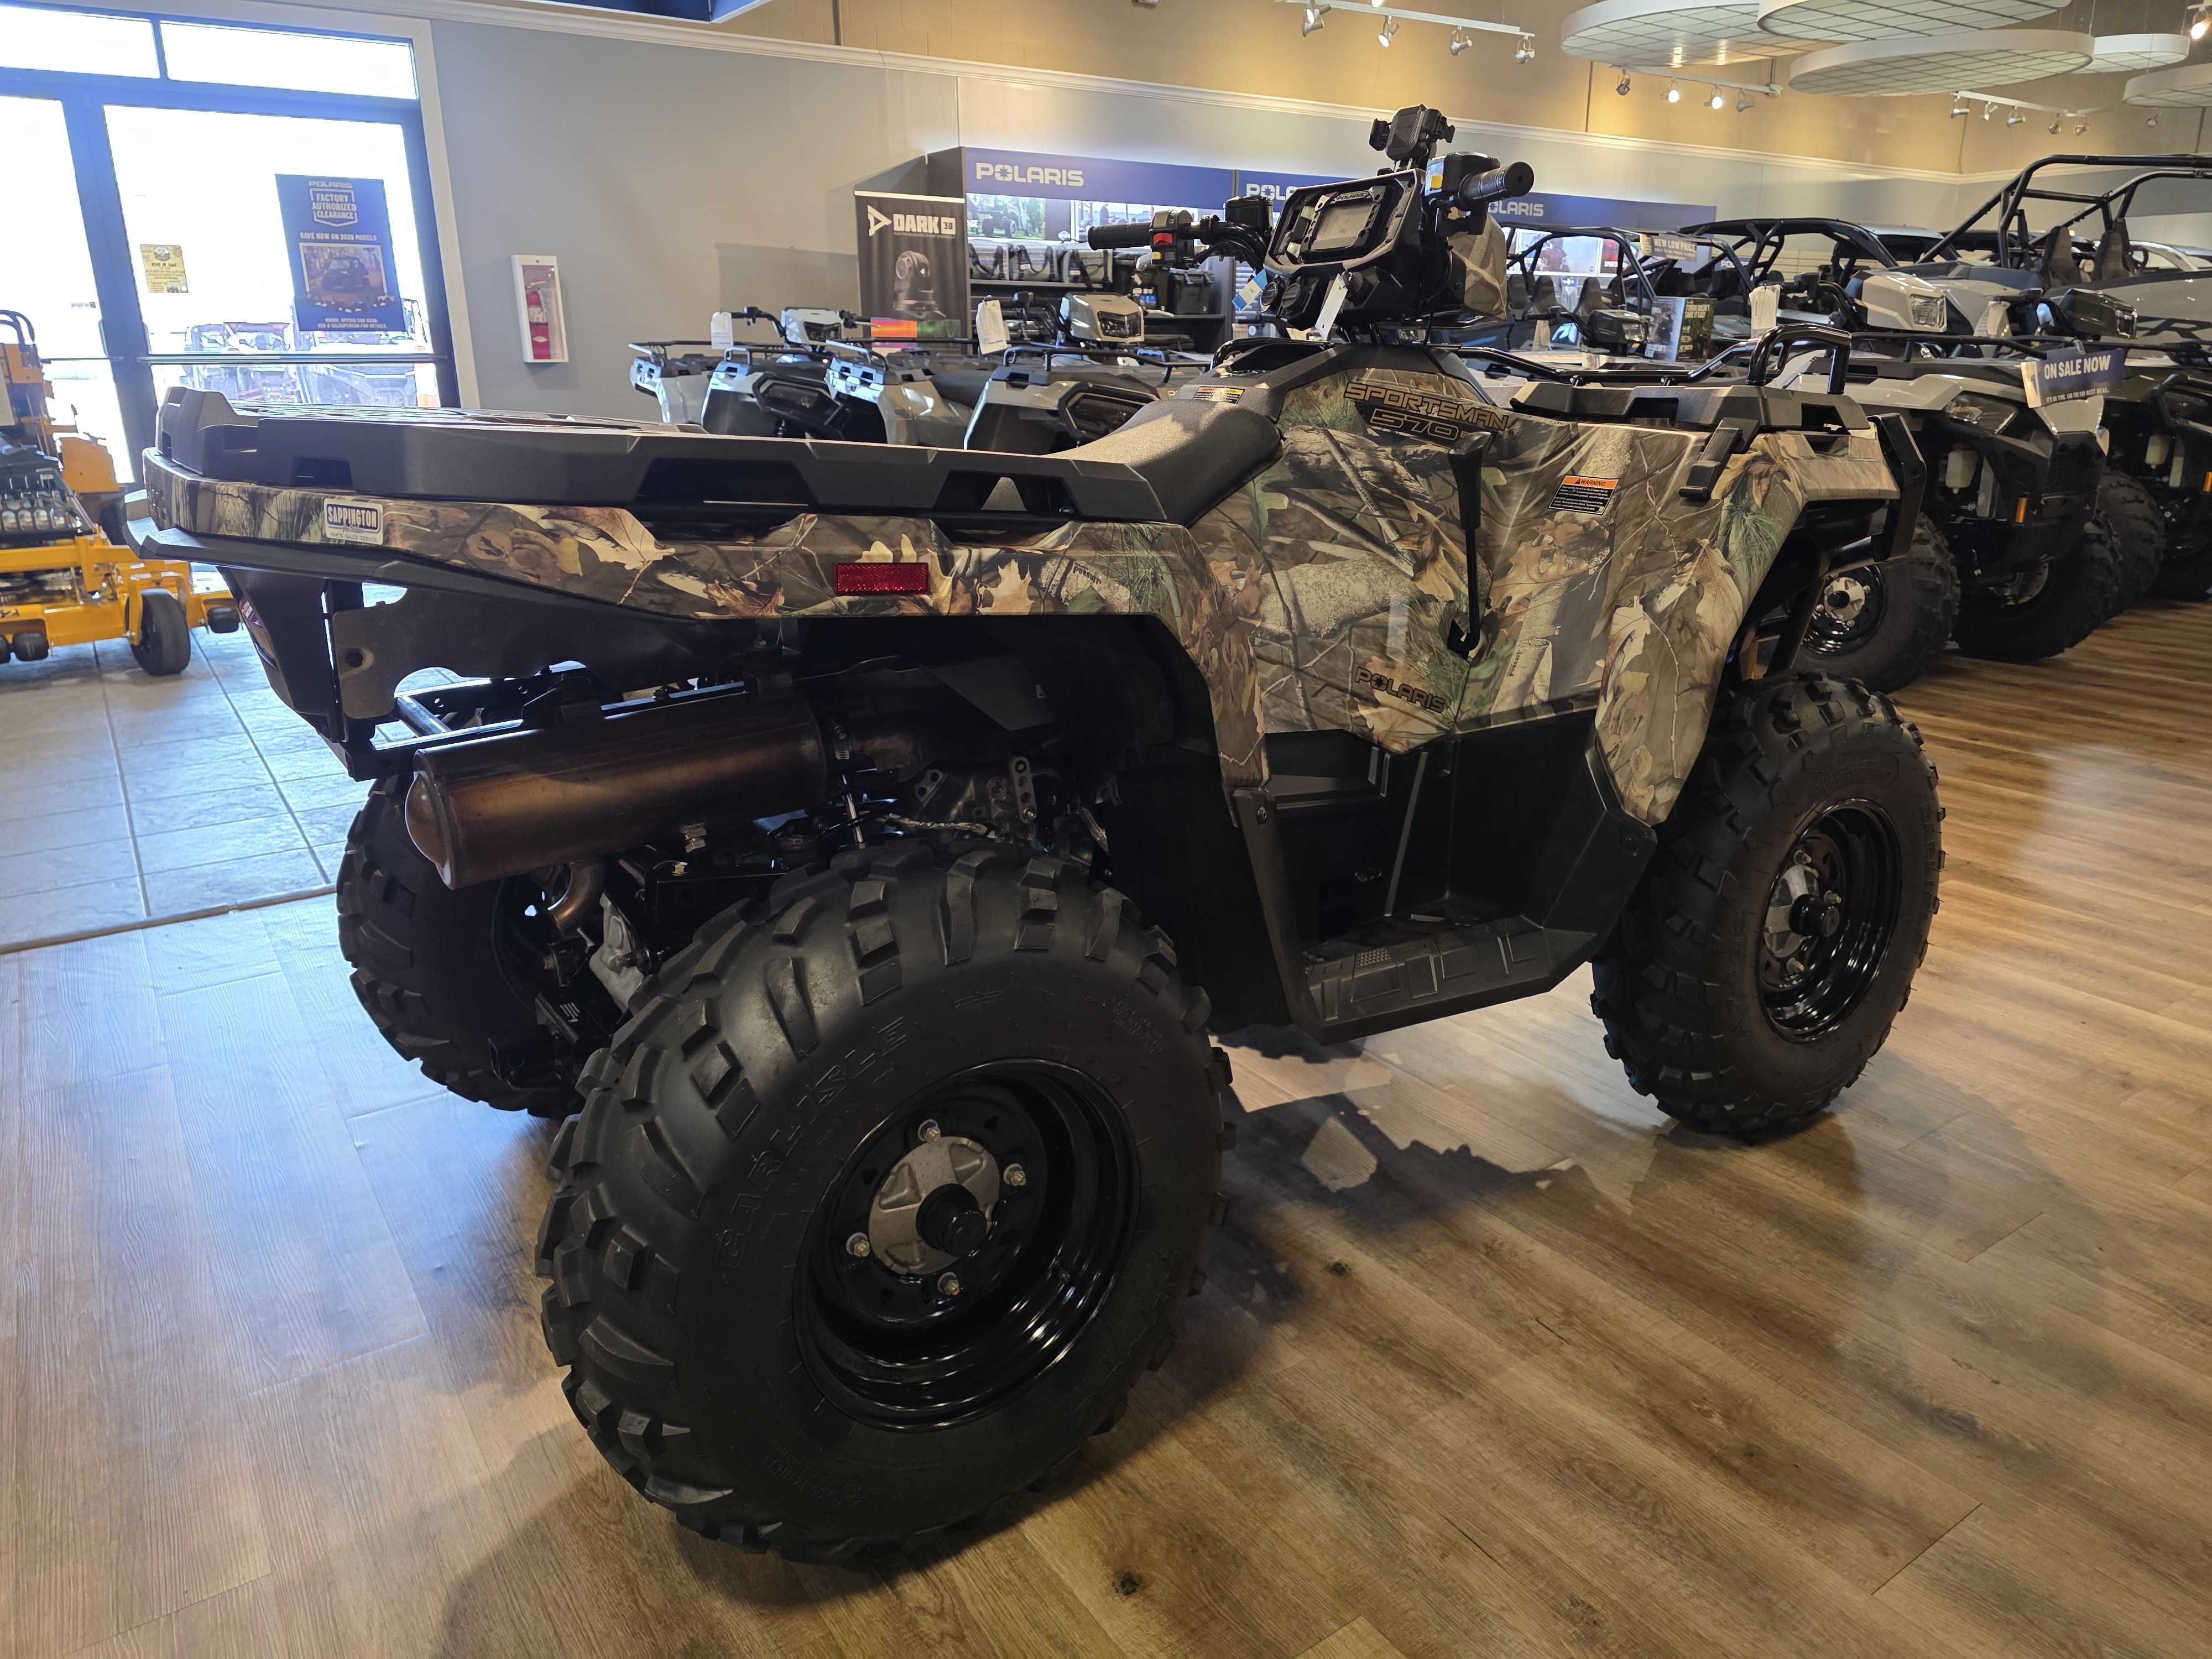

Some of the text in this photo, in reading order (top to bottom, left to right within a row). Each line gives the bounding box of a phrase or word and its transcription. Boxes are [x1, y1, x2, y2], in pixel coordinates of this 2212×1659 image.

[975, 163, 1084, 186] POLARIS
[312, 201, 357, 211] AUTHORIZED
[316, 194, 348, 202] FACTORY
[1488, 200, 1544, 217] OLARIS
[316, 210, 355, 220] CLEARANCE
[893, 213, 939, 234] DARK
[1654, 238, 1667, 248] NEW
[1667, 239, 1680, 250] LOW
[1681, 242, 1696, 253] PRICE
[2044, 354, 2111, 379] ON SALE NOW
[1343, 382, 1510, 431] SPORTSMAN
[1370, 408, 1459, 441] 570
[1580, 478, 1606, 487] WARNING
[327, 506, 377, 528] SAPPINGTON
[1073, 566, 1102, 585] PURSUIT
[1509, 651, 1522, 676] PURSUIT
[1354, 666, 1446, 713] POLARIS
[716, 1016, 908, 1269] CARLISLE
